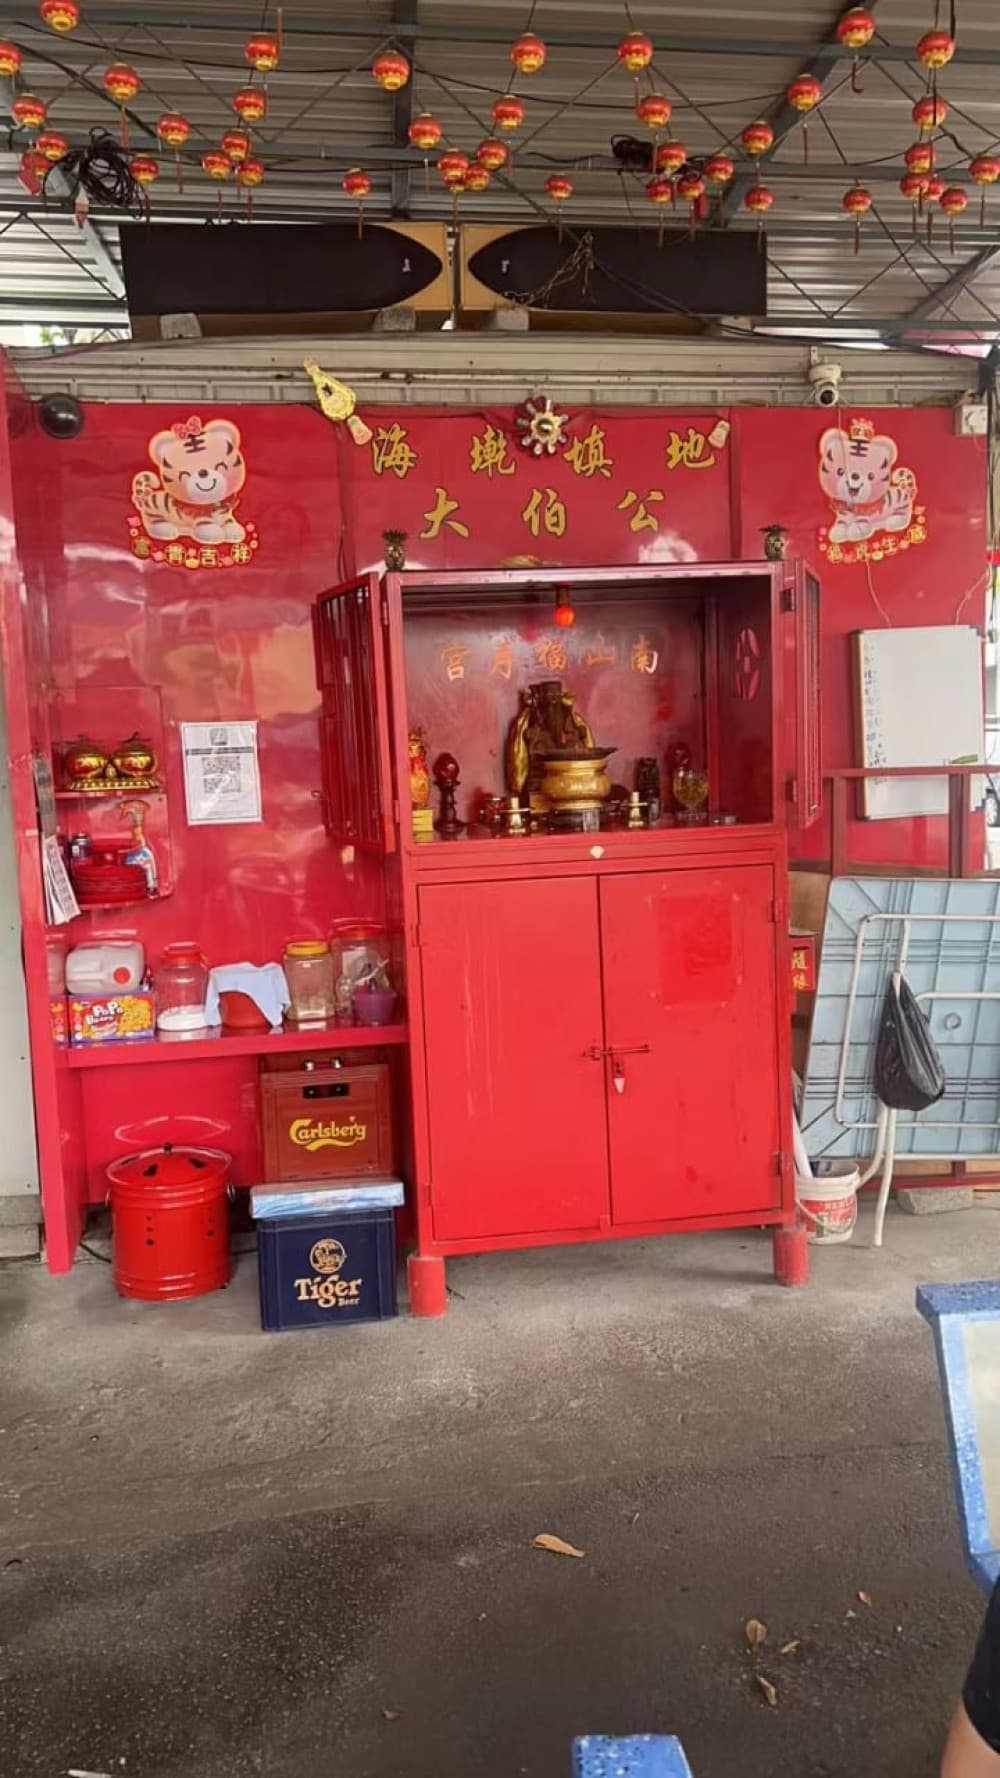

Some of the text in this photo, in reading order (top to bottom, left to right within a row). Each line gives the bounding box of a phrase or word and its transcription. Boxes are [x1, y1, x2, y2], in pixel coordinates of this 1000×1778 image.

[419, 487, 666, 540] 大伯公
[290, 1116, 367, 1151] Carlsberg
[294, 1275, 362, 1308] Tiger
